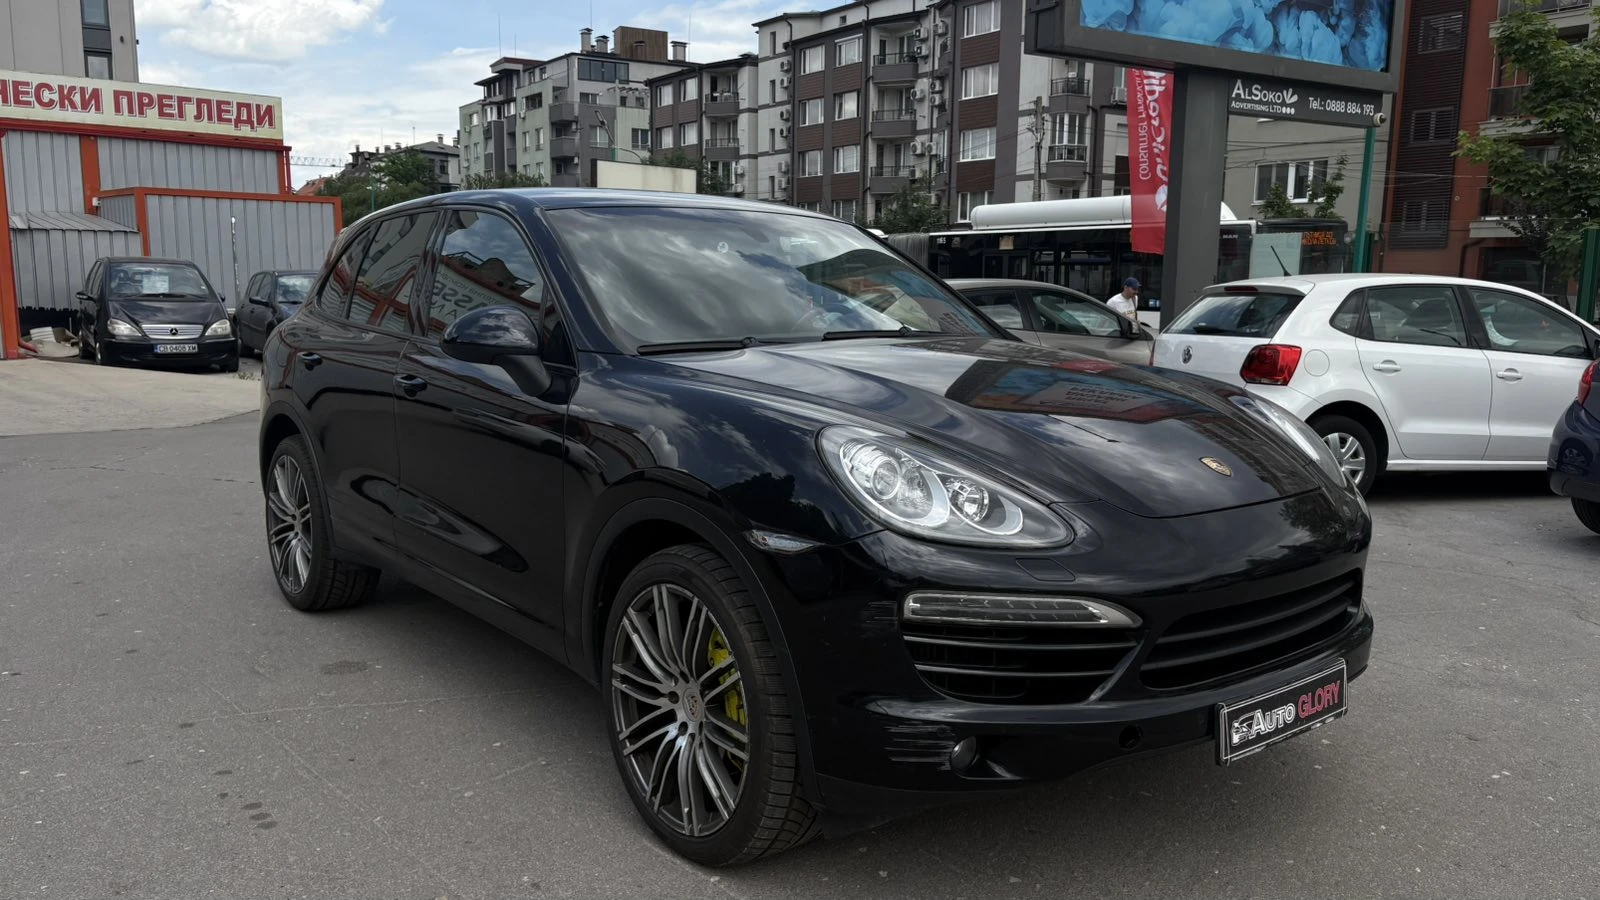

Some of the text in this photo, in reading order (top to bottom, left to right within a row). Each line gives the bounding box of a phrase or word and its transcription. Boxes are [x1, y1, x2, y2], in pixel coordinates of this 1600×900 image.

[113, 90, 275, 131] ПРЕГЛЕДИ
[1325, 99, 1346, 112] 0888
[1346, 102, 1361, 114] 884
[1362, 104, 1375, 116] 193
[1297, 681, 1340, 718] GLORY
